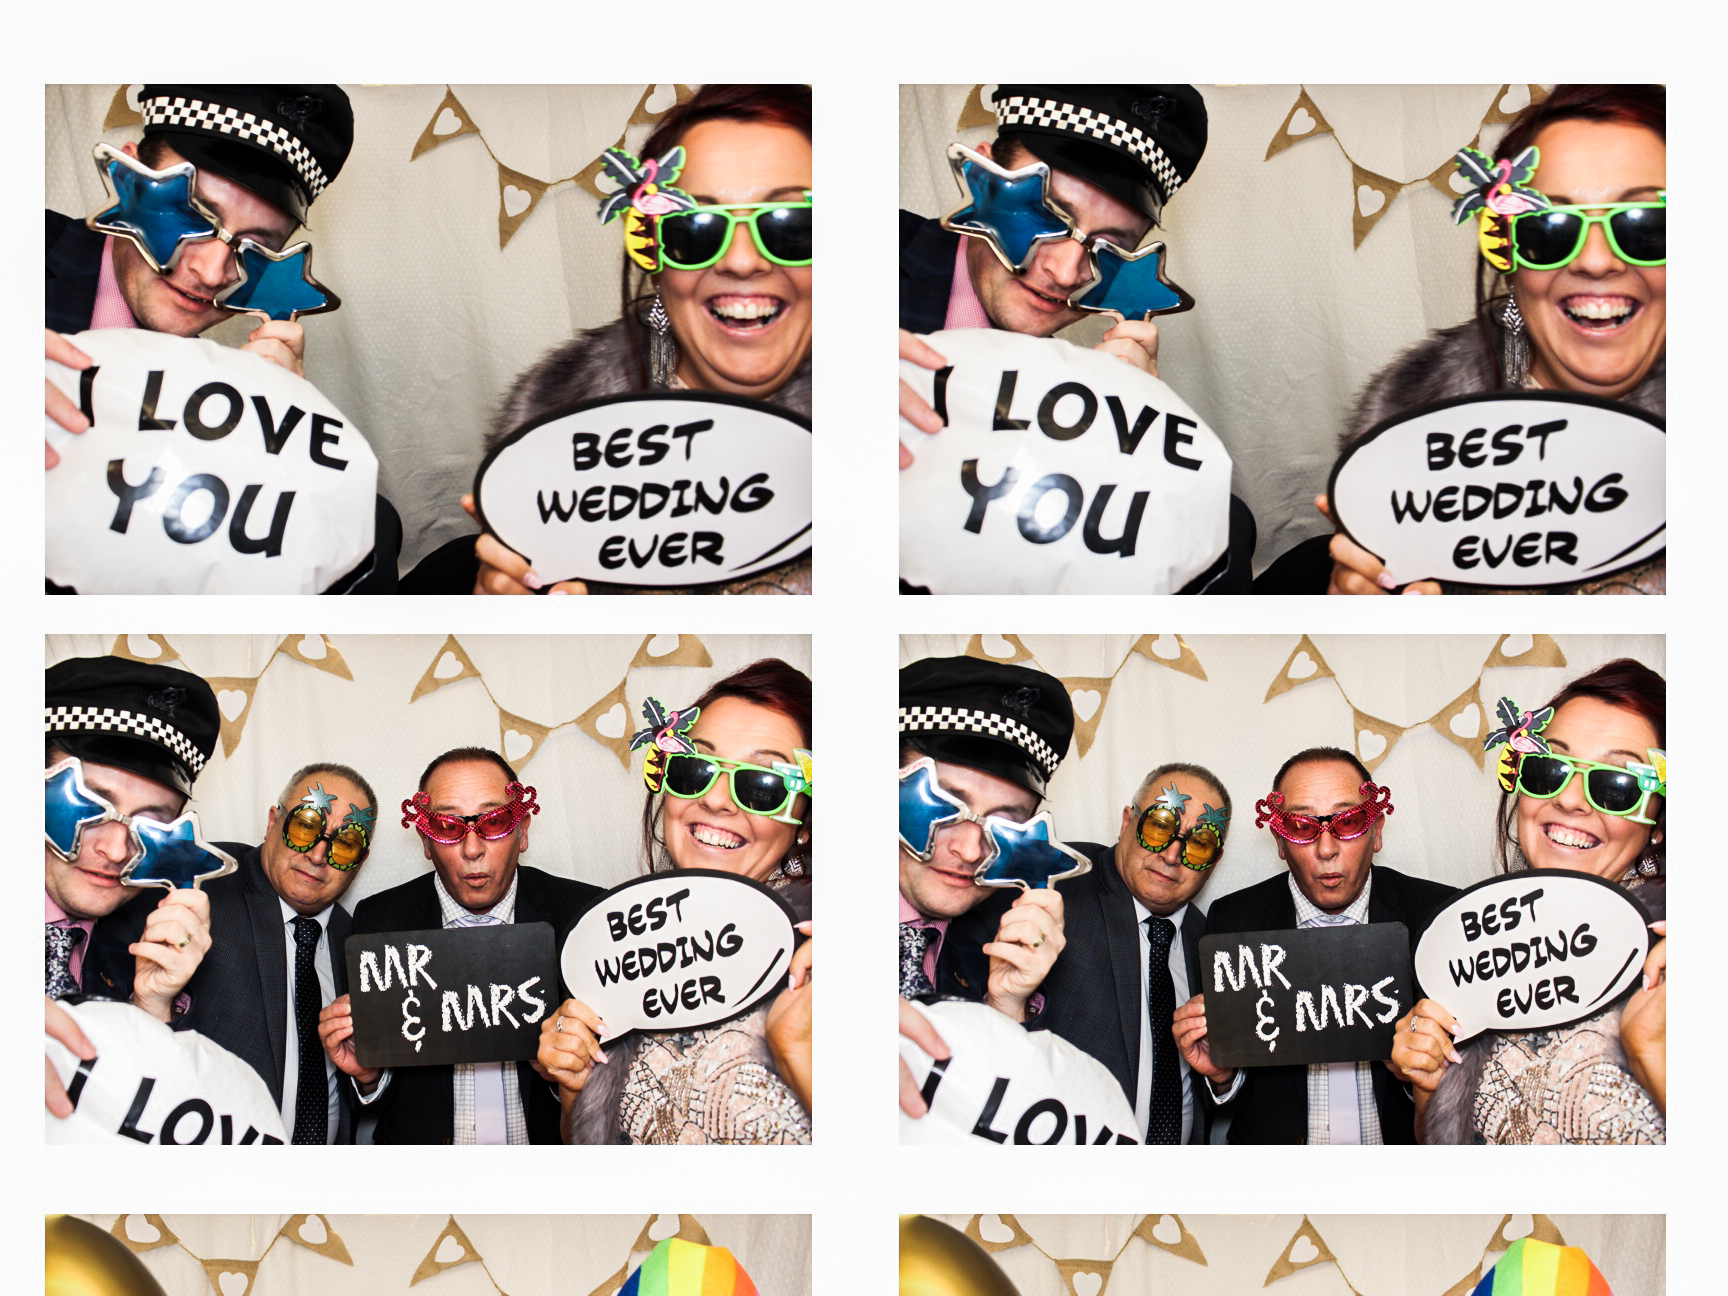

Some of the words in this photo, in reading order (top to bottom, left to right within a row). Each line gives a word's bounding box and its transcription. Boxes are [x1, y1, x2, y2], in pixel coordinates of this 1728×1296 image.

[138, 370, 349, 471] LOVE
[572, 418, 714, 471] BEST
[992, 370, 1203, 471] LOVE
[1426, 418, 1568, 471] BEST
[106, 458, 297, 558] YOU
[537, 472, 775, 525] WEDDING
[960, 458, 1151, 558] YOU
[1391, 472, 1629, 525] WEDDING
[598, 531, 725, 570] EVER
[1452, 531, 1579, 570] EVER
[606, 888, 691, 942] BEST
[1460, 888, 1545, 942] BEST
[359, 943, 438, 992] MR
[594, 923, 744, 988] WEDDING
[1213, 943, 1292, 992] MR
[1448, 923, 1598, 988] WEDDING
[441, 975, 548, 1033] MRS
[642, 975, 726, 1019] EVER
[1295, 975, 1402, 1033] MRS
[1496, 975, 1580, 1019] EVER
